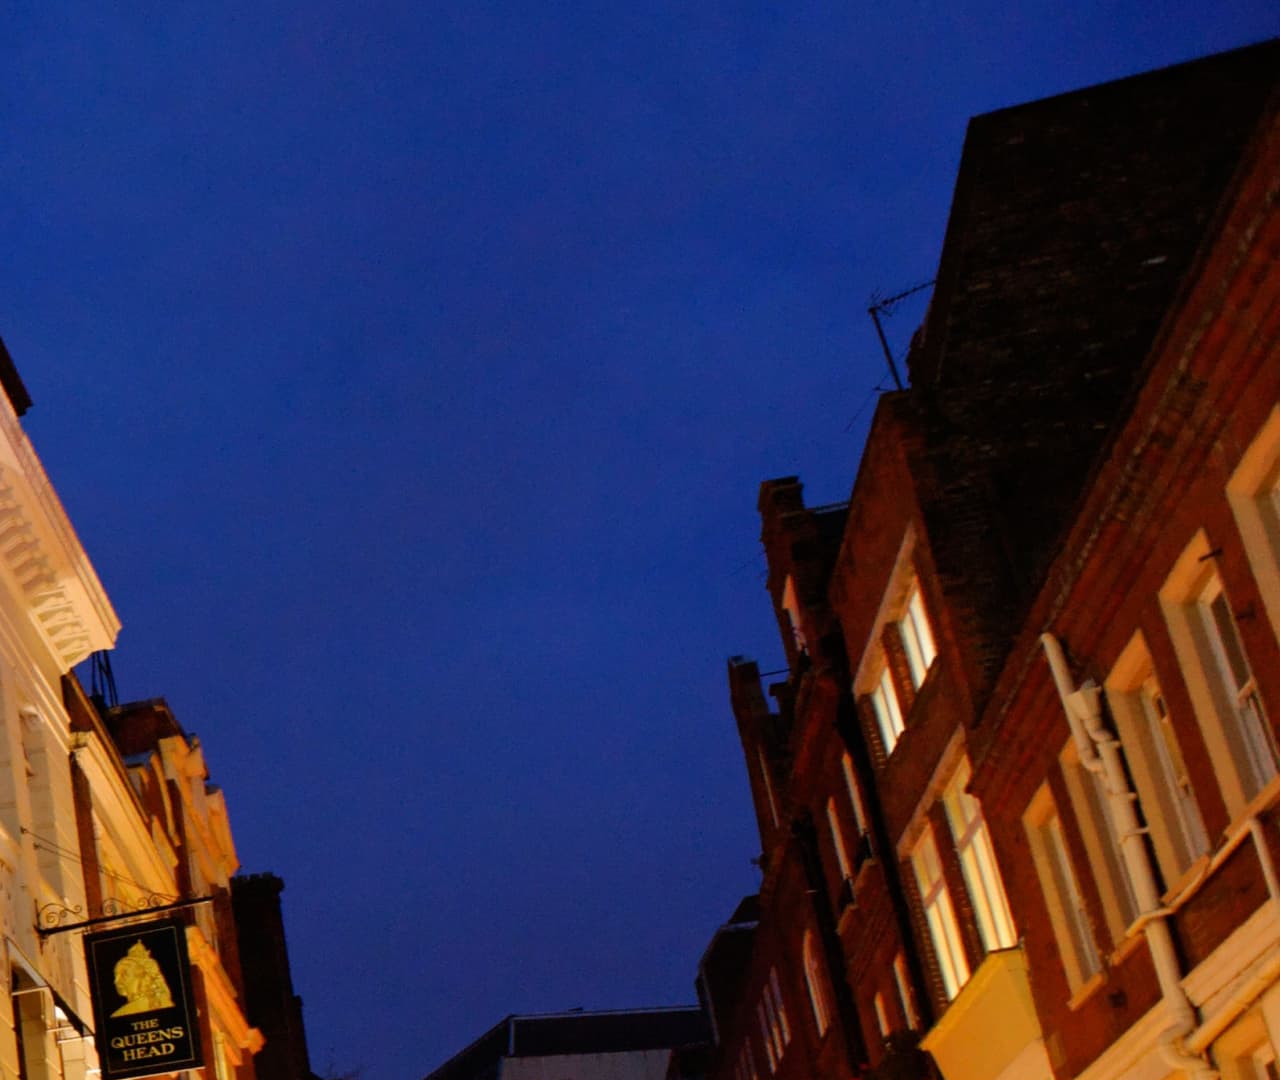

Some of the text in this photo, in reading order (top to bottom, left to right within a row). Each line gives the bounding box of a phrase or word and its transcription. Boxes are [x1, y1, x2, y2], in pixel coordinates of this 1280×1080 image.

[131, 1018, 159, 1032] THE
[111, 1026, 184, 1050] QUEENS
[123, 1042, 175, 1062] HEAD
